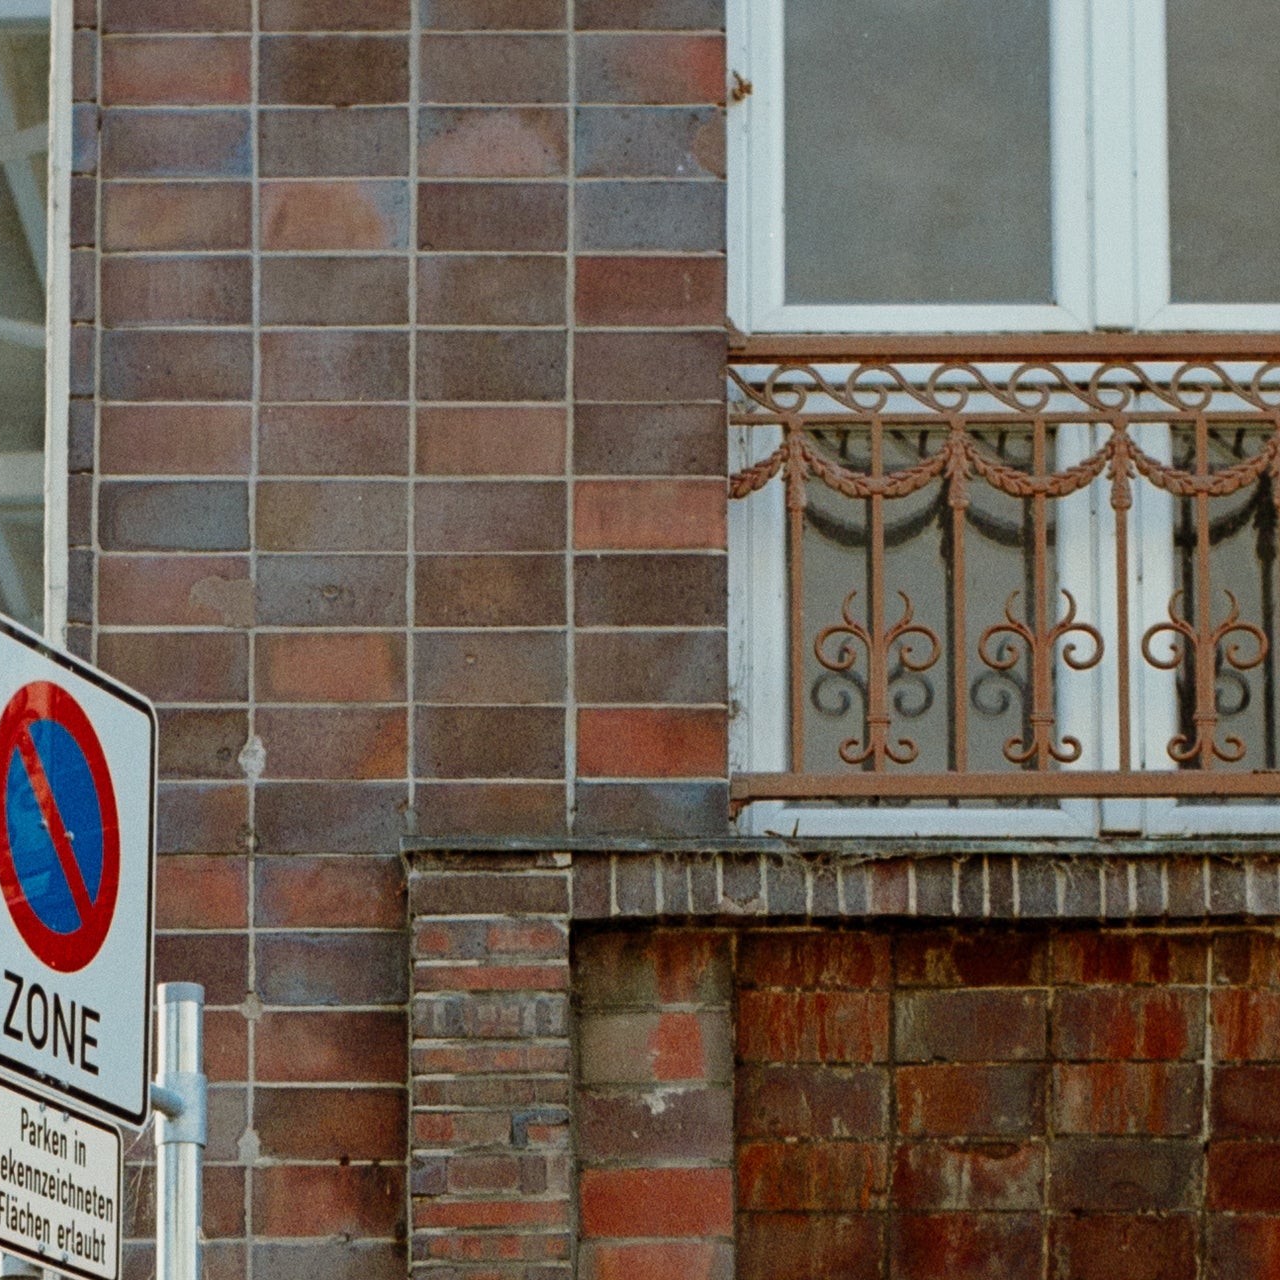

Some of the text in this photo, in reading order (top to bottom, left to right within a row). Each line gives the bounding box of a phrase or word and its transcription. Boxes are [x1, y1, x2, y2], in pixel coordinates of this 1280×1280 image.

[2, 968, 101, 1076] ZONE
[19, 1106, 87, 1169] Parken in
[56, 1219, 106, 1266] erlaubt
